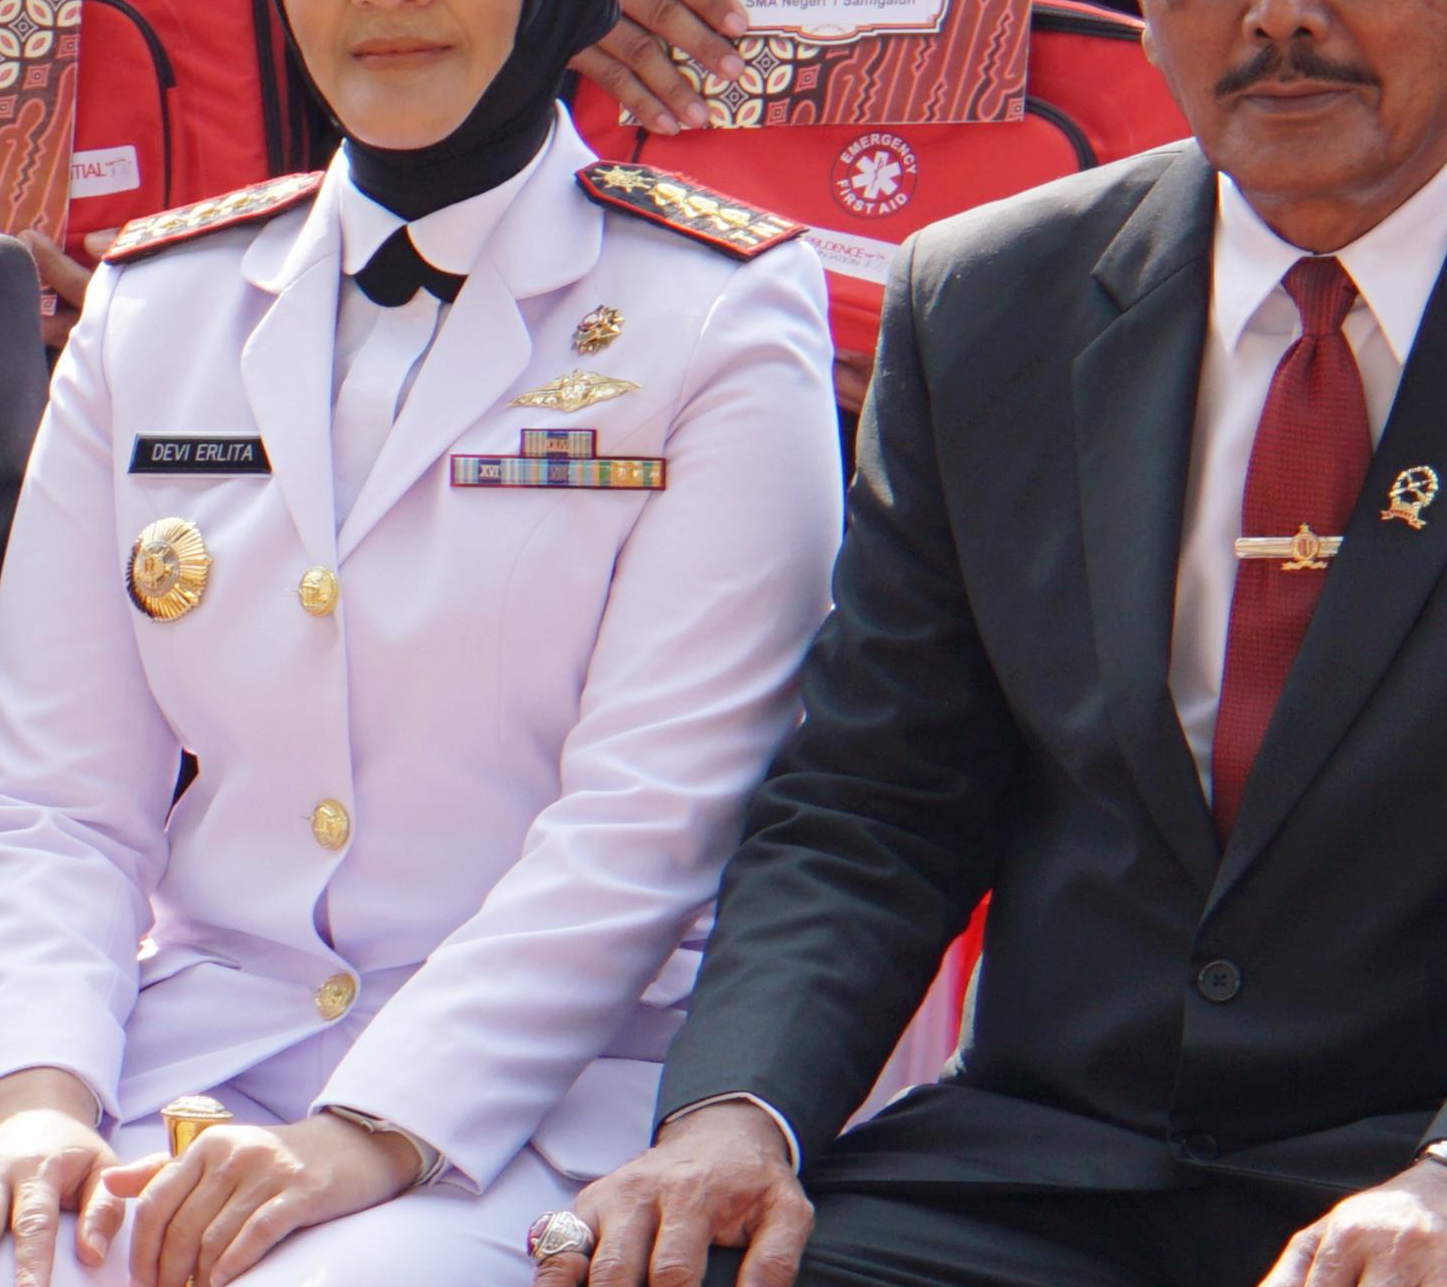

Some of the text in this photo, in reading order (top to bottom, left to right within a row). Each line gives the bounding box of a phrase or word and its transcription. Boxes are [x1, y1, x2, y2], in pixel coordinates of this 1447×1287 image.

[840, 133, 918, 174] EMERGENCY
[837, 179, 908, 215] FIRST AID
[151, 443, 254, 462] DEVI ERLITA
